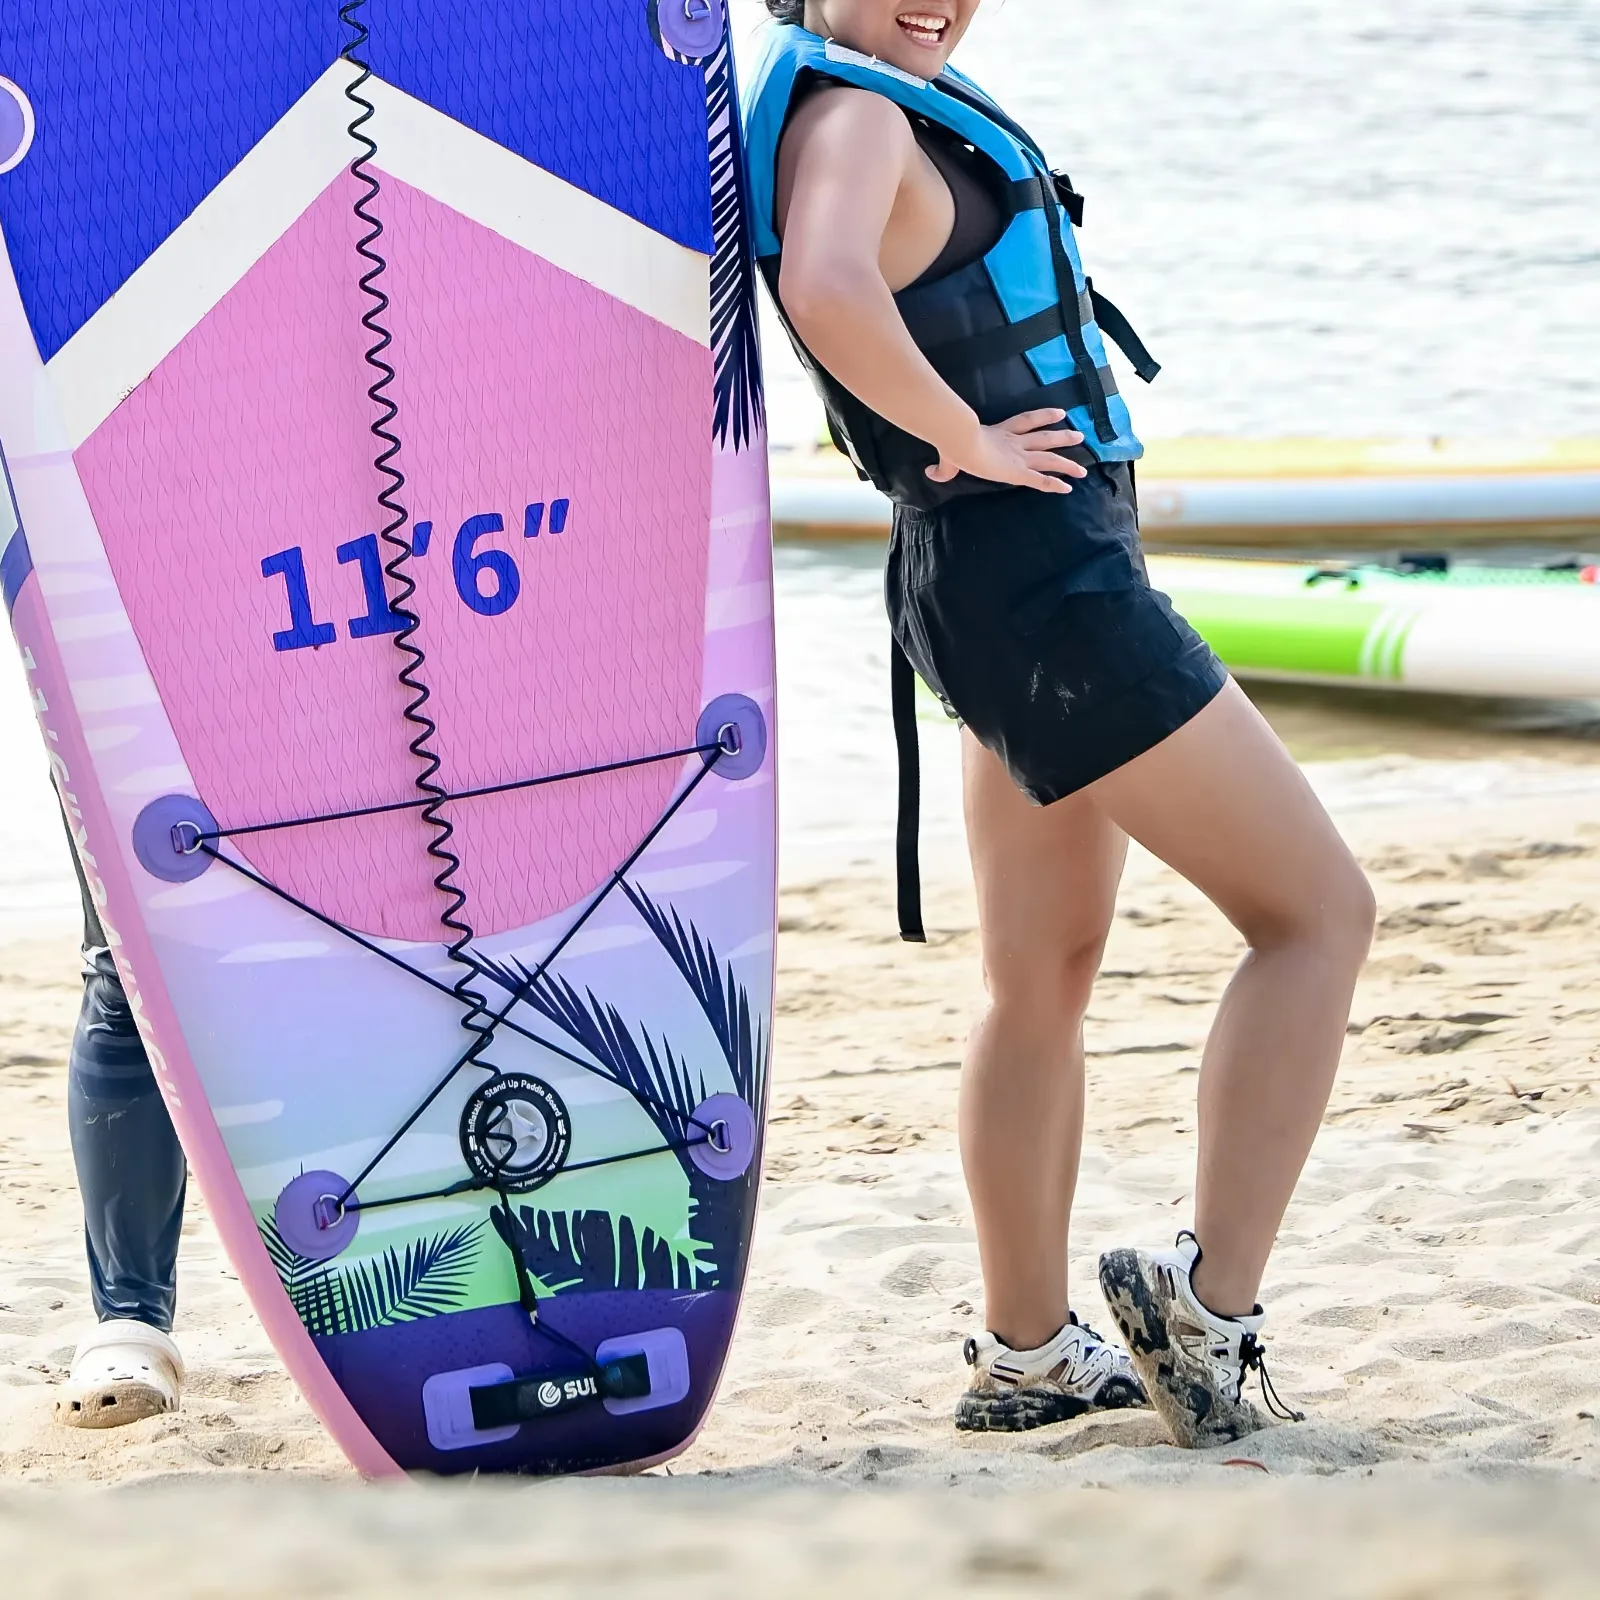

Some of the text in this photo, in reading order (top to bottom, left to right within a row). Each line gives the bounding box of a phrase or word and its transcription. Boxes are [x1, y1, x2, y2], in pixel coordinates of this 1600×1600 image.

[467, 1079, 563, 1133] Inflatabl Stand Up Paddle Board
